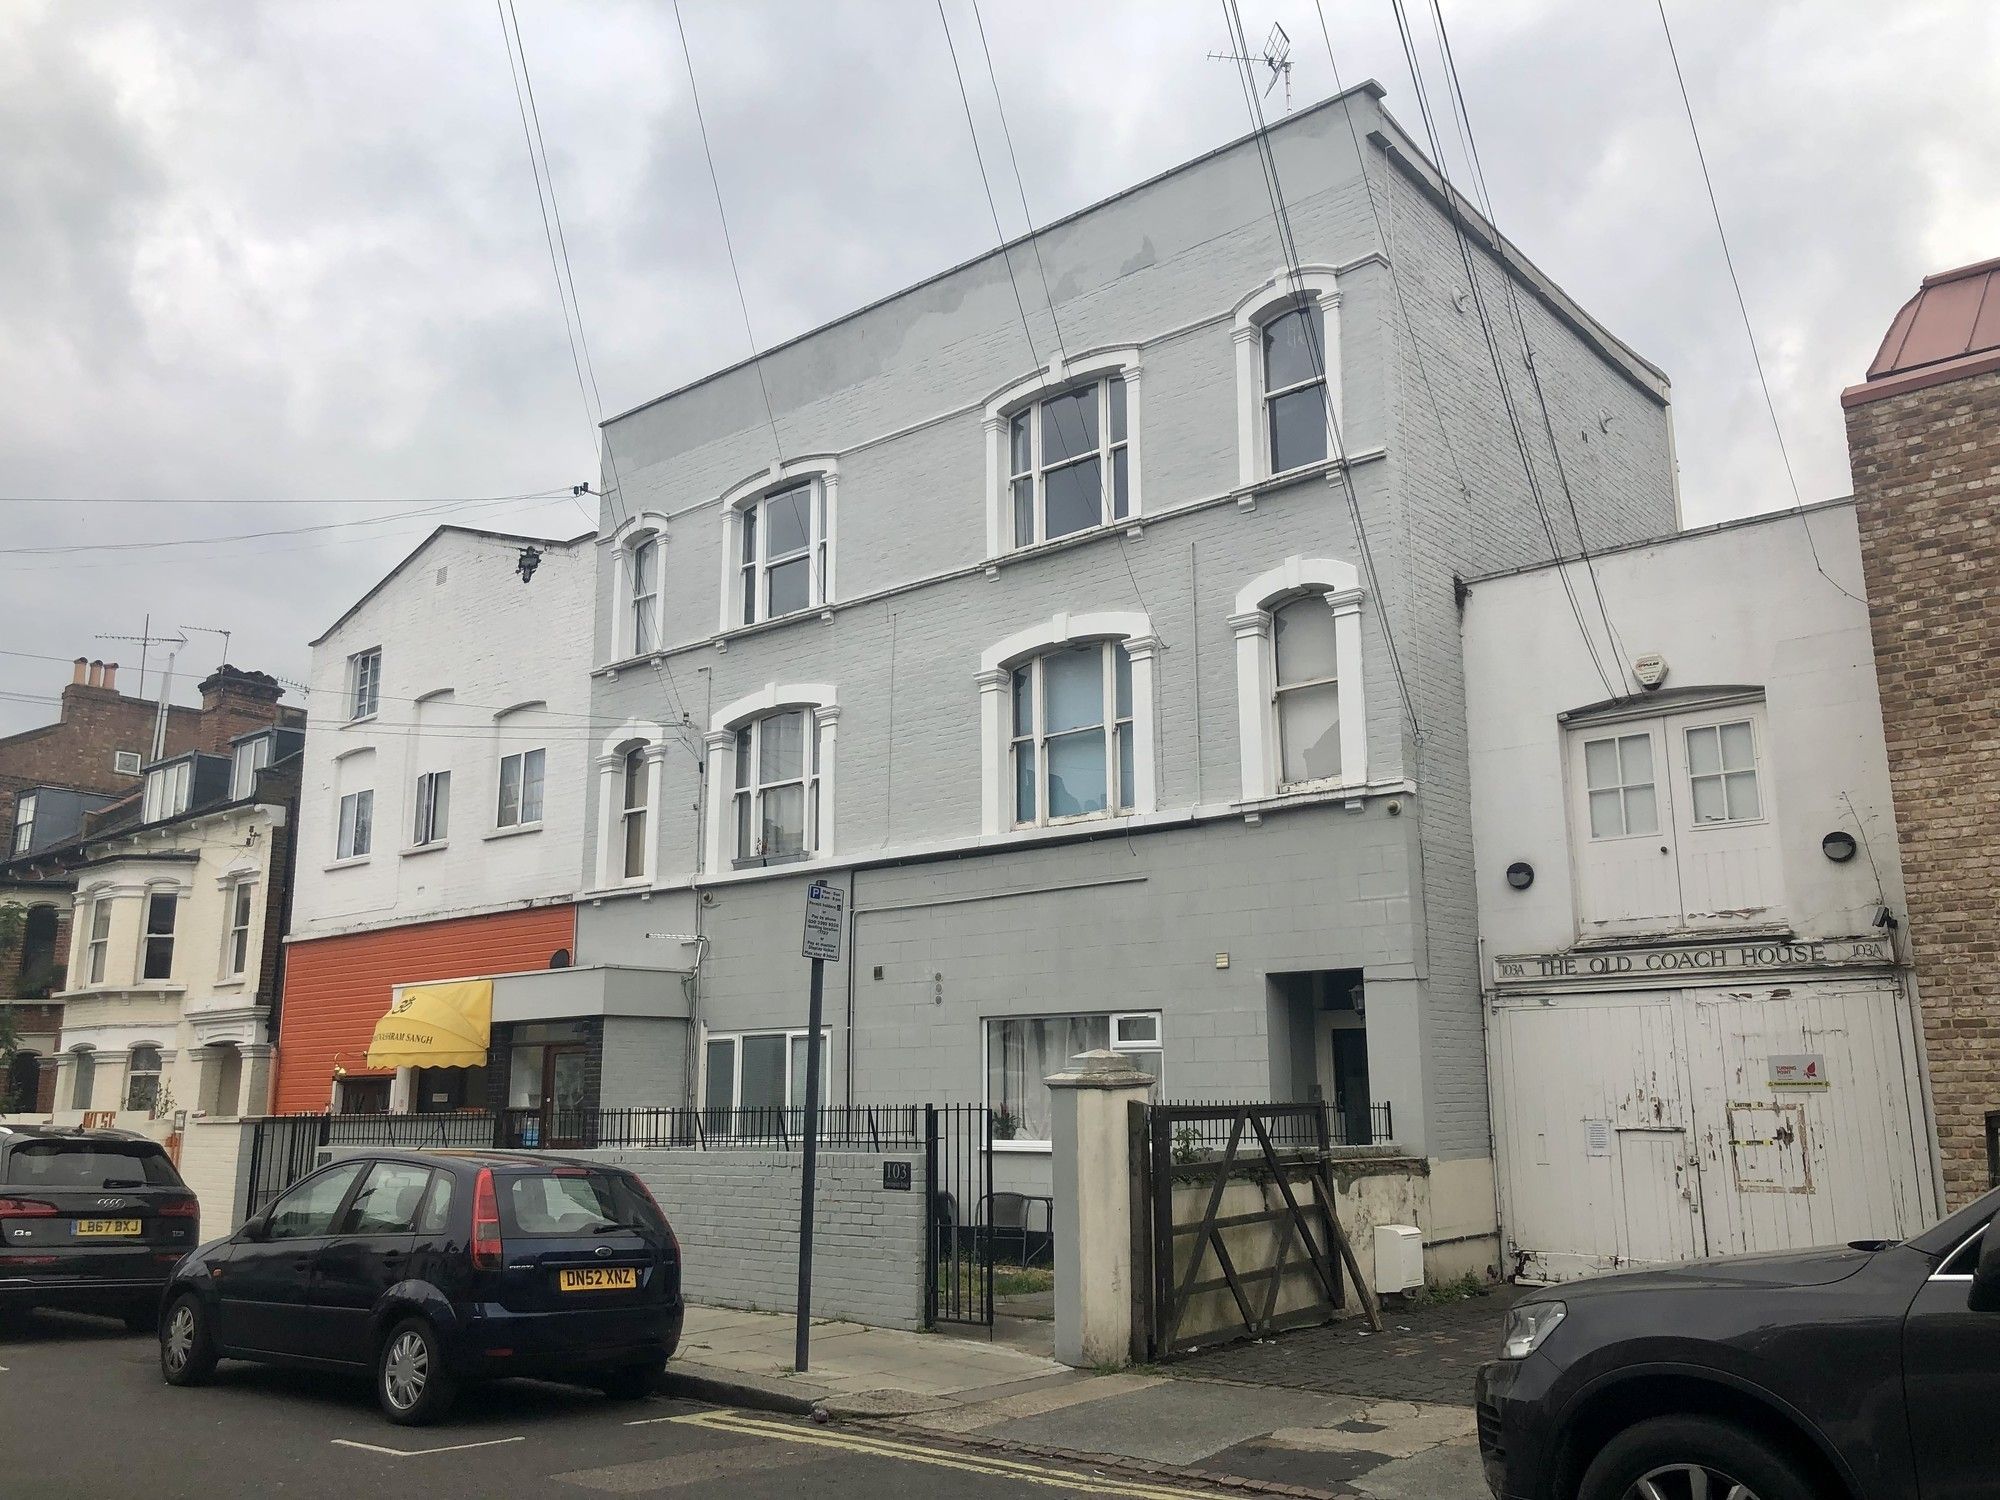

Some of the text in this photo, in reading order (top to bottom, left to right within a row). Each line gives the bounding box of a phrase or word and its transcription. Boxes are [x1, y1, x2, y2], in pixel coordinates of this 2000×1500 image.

[1502, 943, 1884, 976] 103A THE OLD COACH HOUSE 103A
[405, 1033, 433, 1045] SANGH
[886, 1163, 907, 1179] 103
[78, 1219, 139, 1233] LB67 BXJ
[567, 1269, 631, 1287] DN52 XNZ
